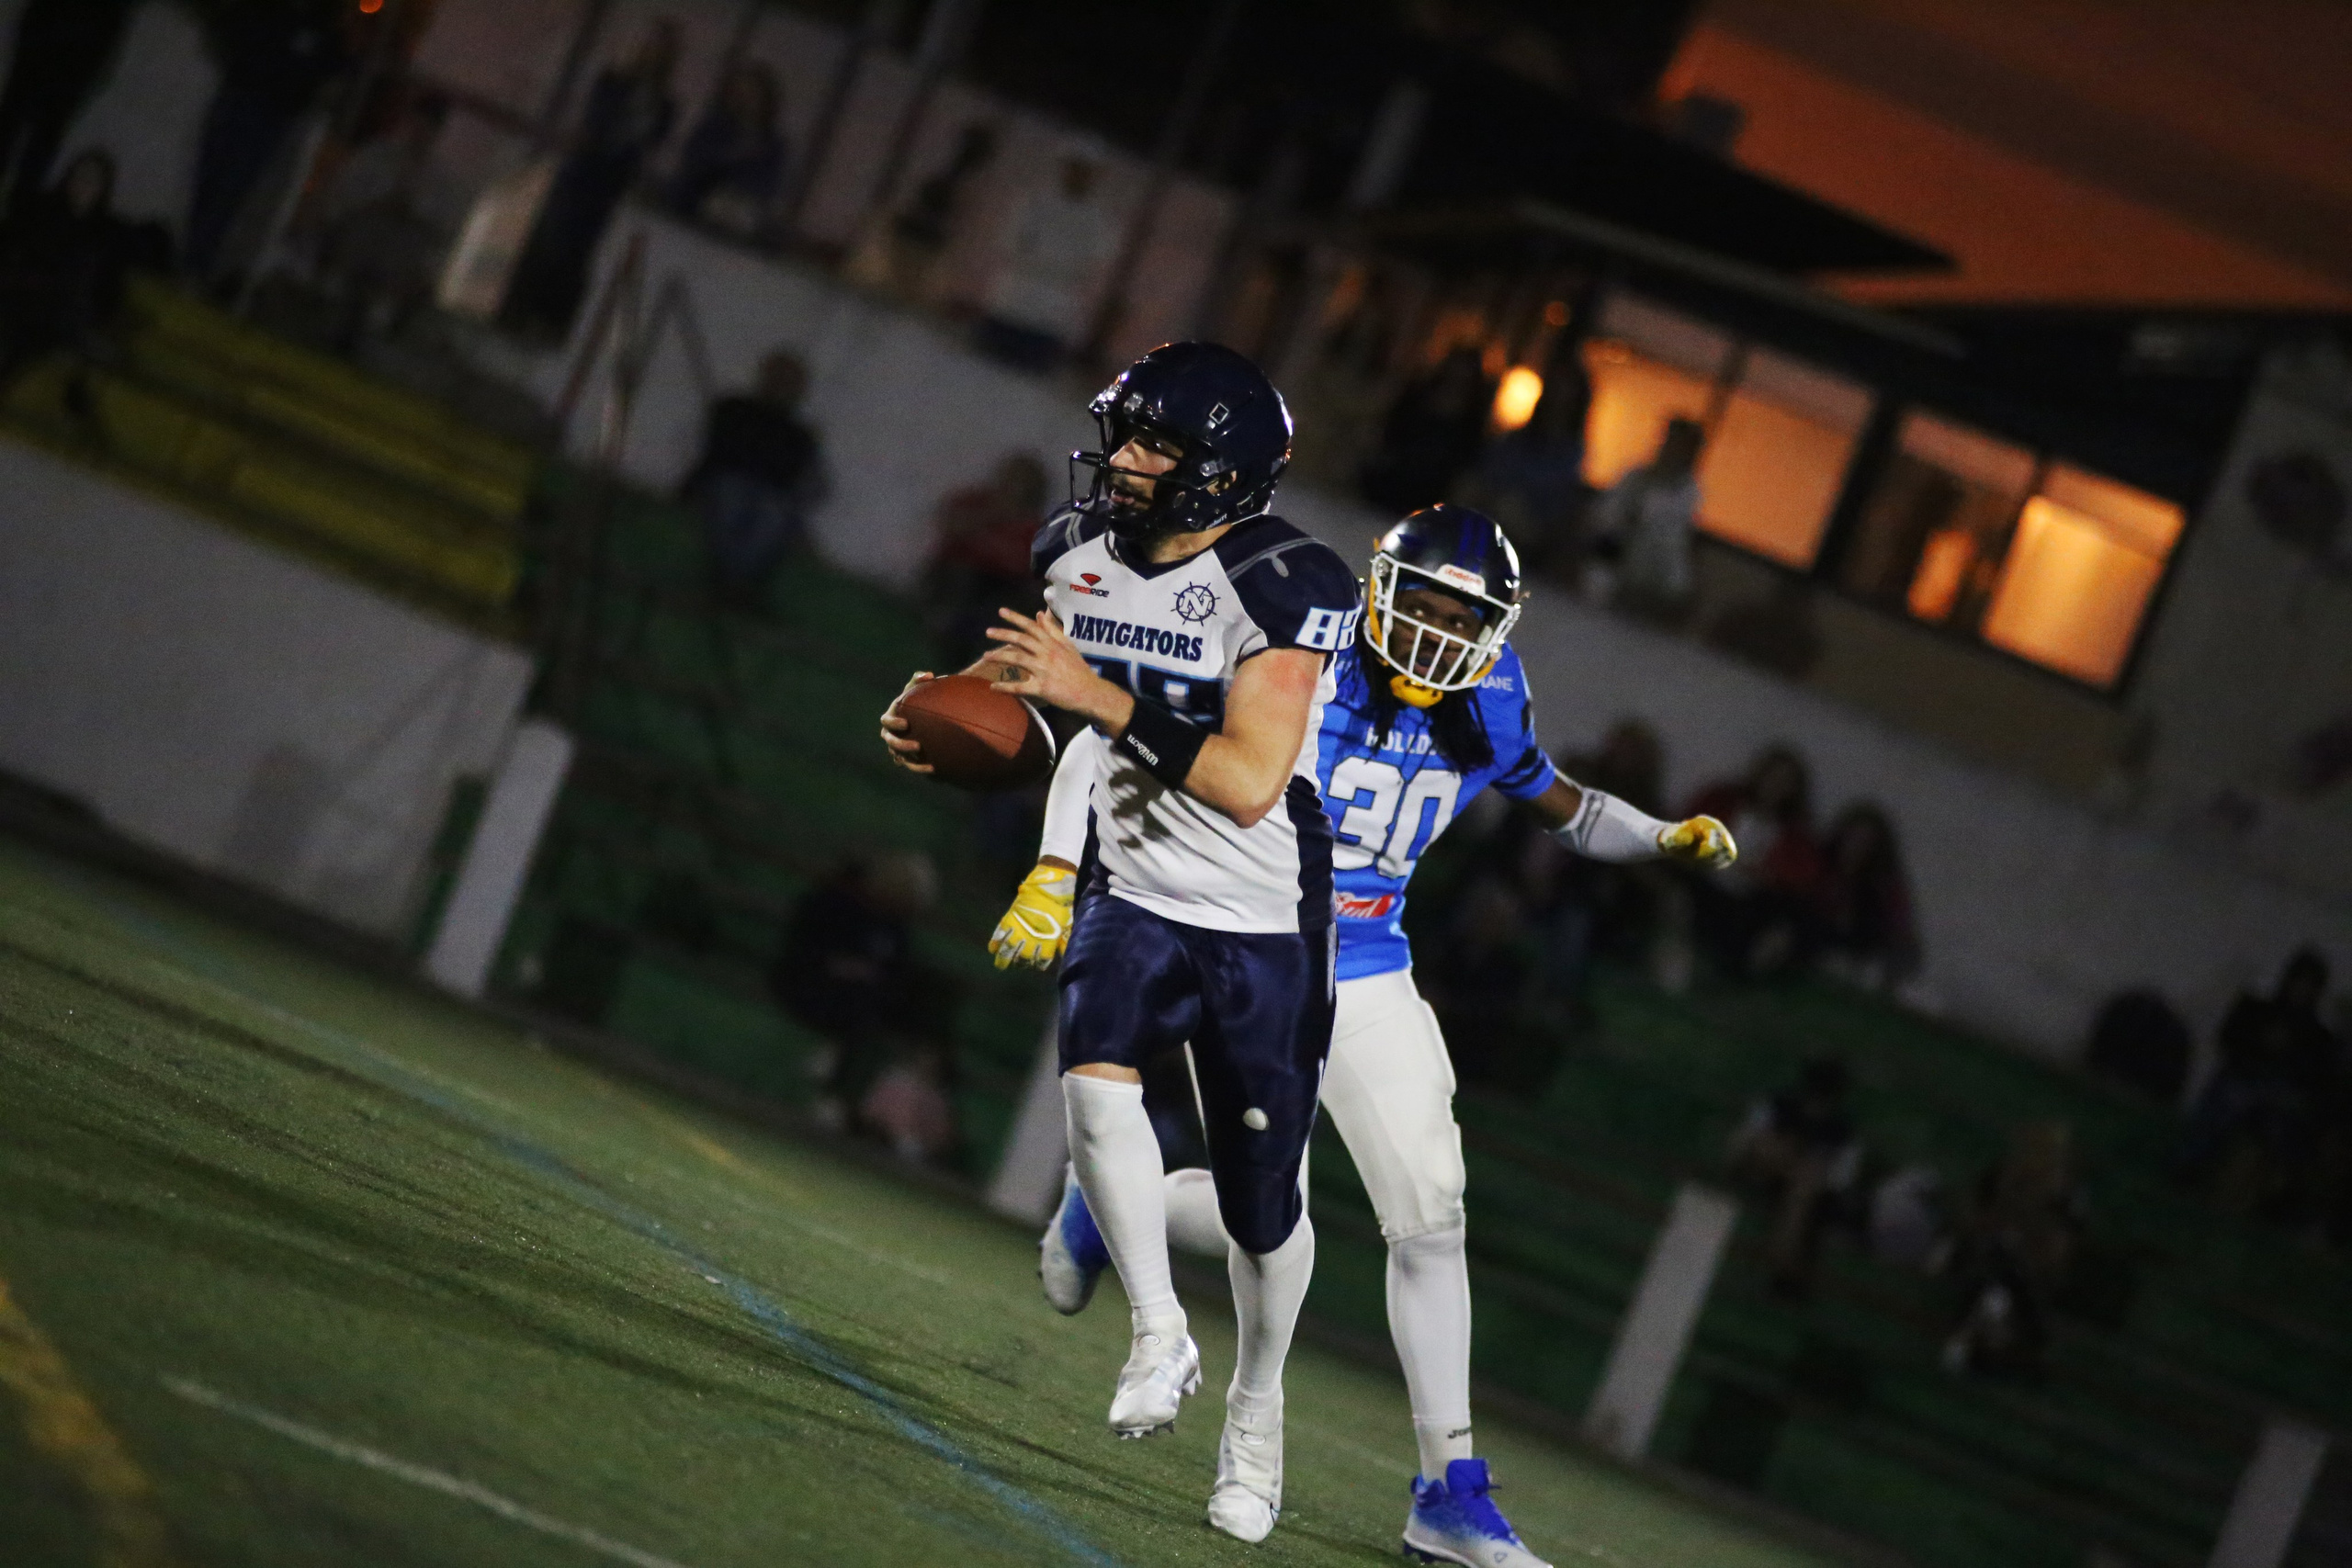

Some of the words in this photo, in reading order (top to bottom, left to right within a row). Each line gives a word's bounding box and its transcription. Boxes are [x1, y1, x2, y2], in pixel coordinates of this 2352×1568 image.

[1069, 583, 1111, 598] FREERIDE
[1070, 613, 1204, 662] NAVIGATORS
[1127, 734, 1159, 766] Wilson
[1328, 755, 1463, 879] 30
